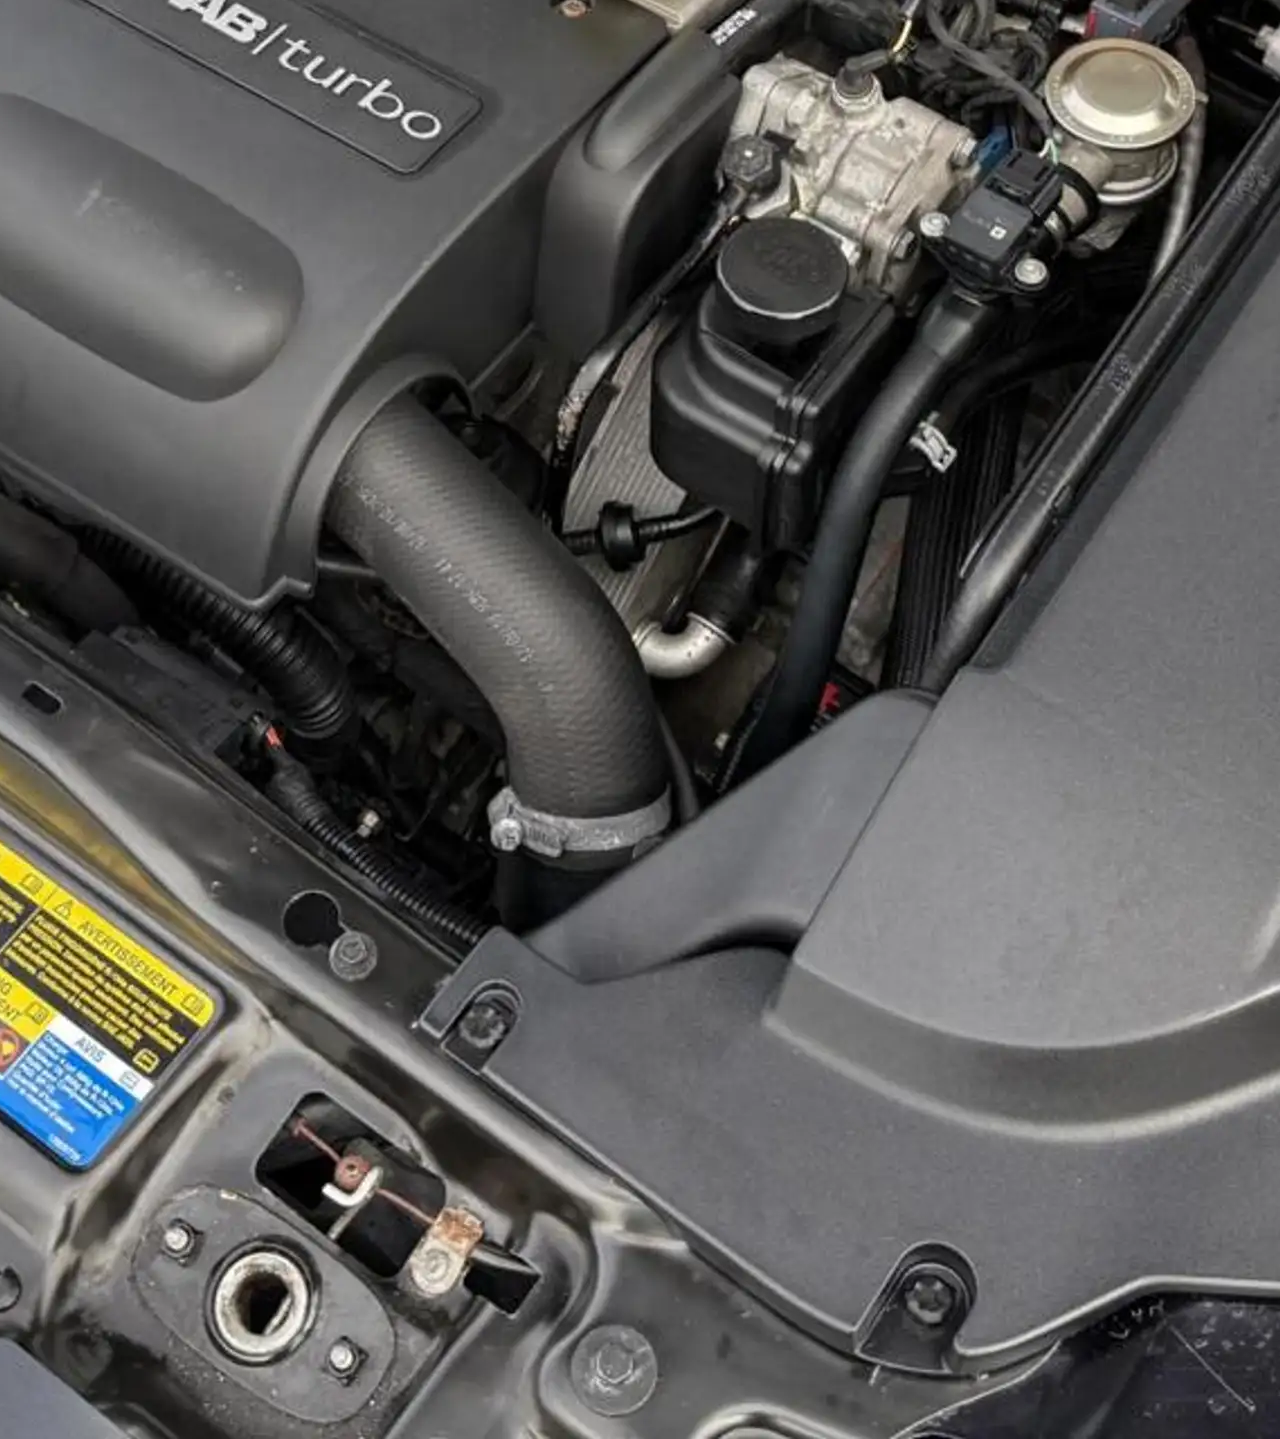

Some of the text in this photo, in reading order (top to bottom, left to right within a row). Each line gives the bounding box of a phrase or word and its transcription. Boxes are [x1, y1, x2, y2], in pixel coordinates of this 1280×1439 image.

[278, 39, 443, 140] turbo
[77, 920, 181, 997] AVERTISSEMENT
[75, 1036, 107, 1063] AVIS
